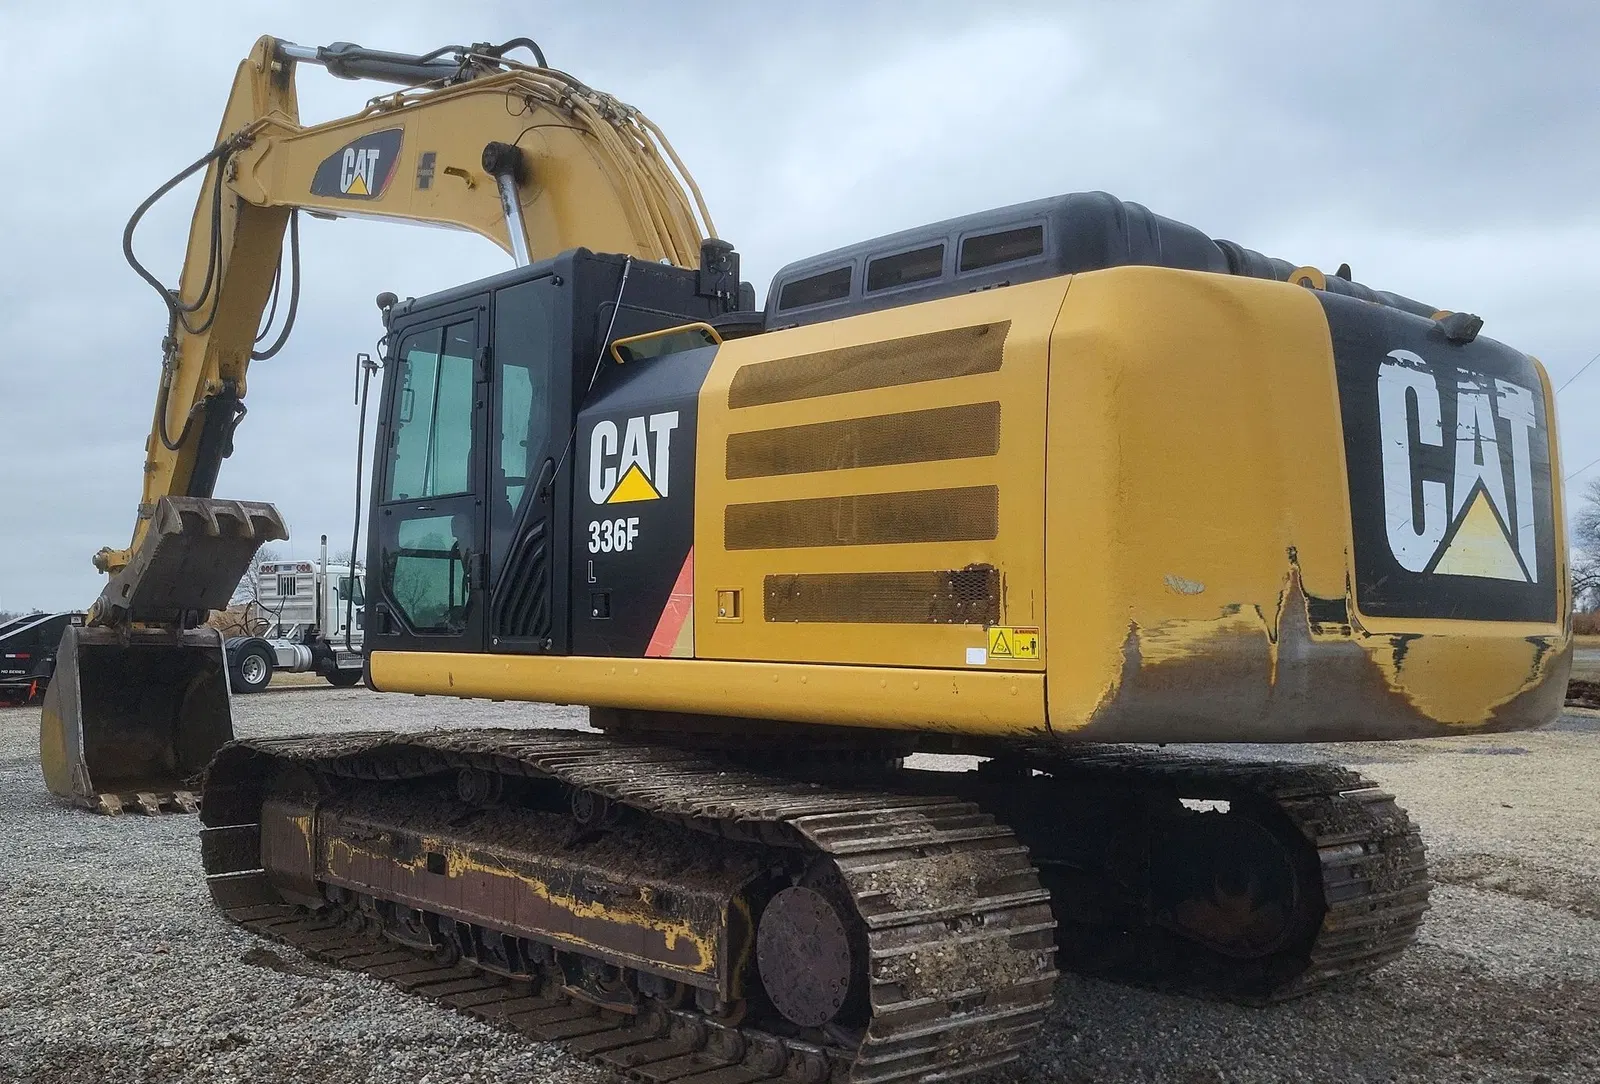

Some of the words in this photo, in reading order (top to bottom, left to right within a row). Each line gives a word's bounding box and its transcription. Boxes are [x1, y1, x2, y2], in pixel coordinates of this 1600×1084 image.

[340, 147, 380, 195] CAT
[588, 410, 679, 505] CAT
[1377, 349, 1538, 584] CAT
[588, 517, 639, 554] 336F
[587, 560, 597, 583] L
